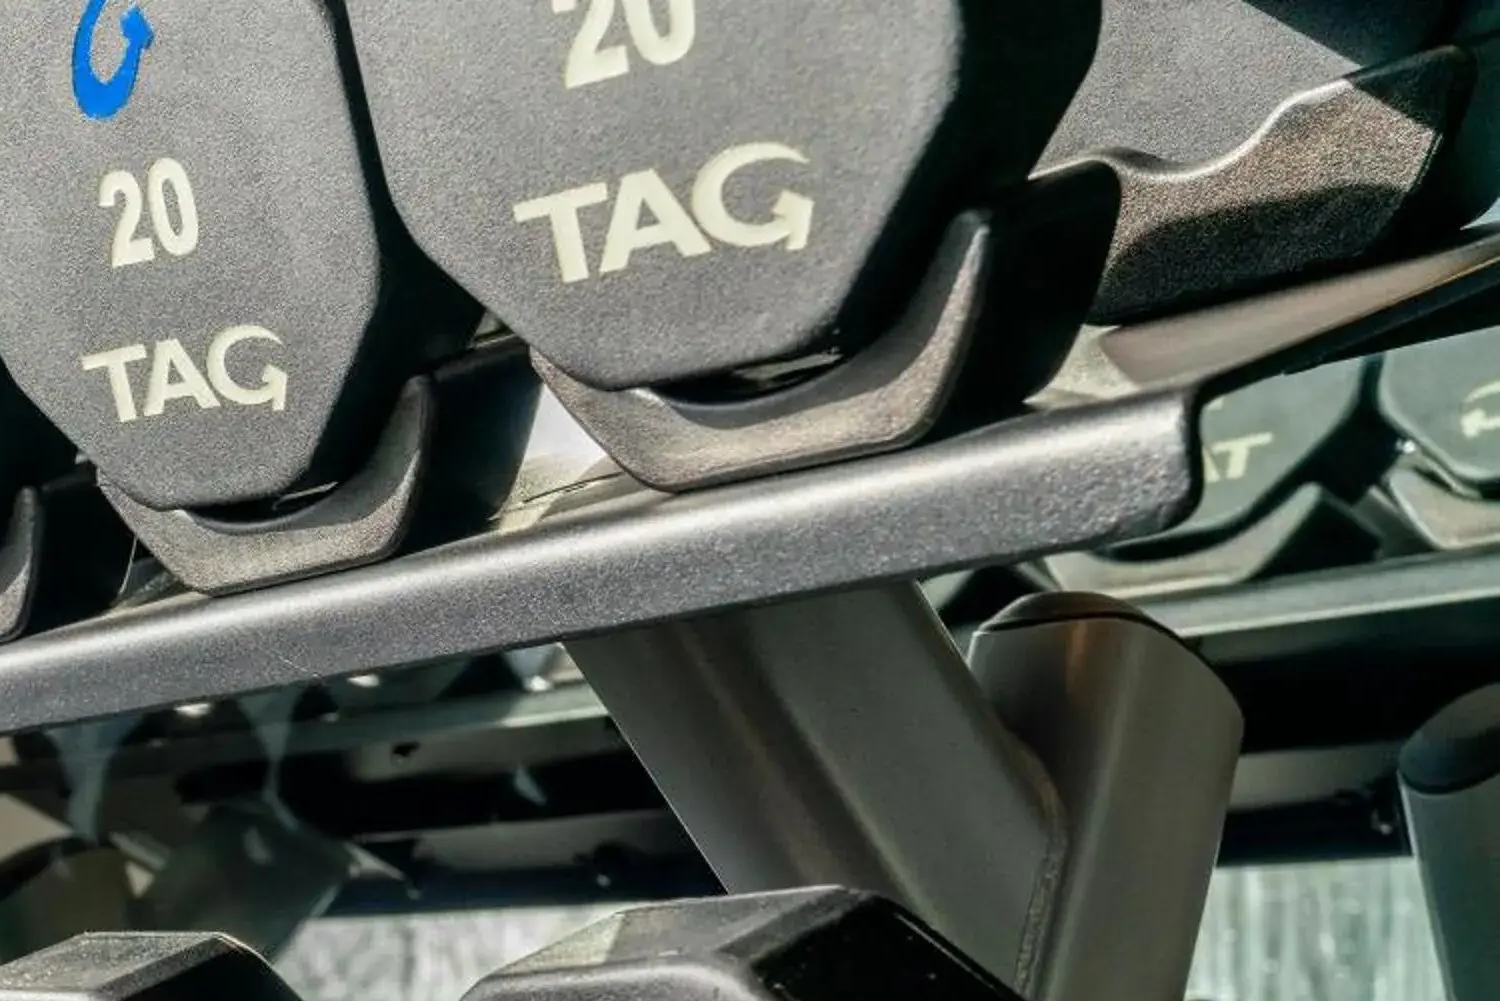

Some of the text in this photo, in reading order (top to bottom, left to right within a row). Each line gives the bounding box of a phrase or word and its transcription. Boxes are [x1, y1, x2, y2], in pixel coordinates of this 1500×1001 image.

[97, 157, 200, 268] 20
[513, 142, 814, 283] TAG
[81, 324, 288, 423] TAG
